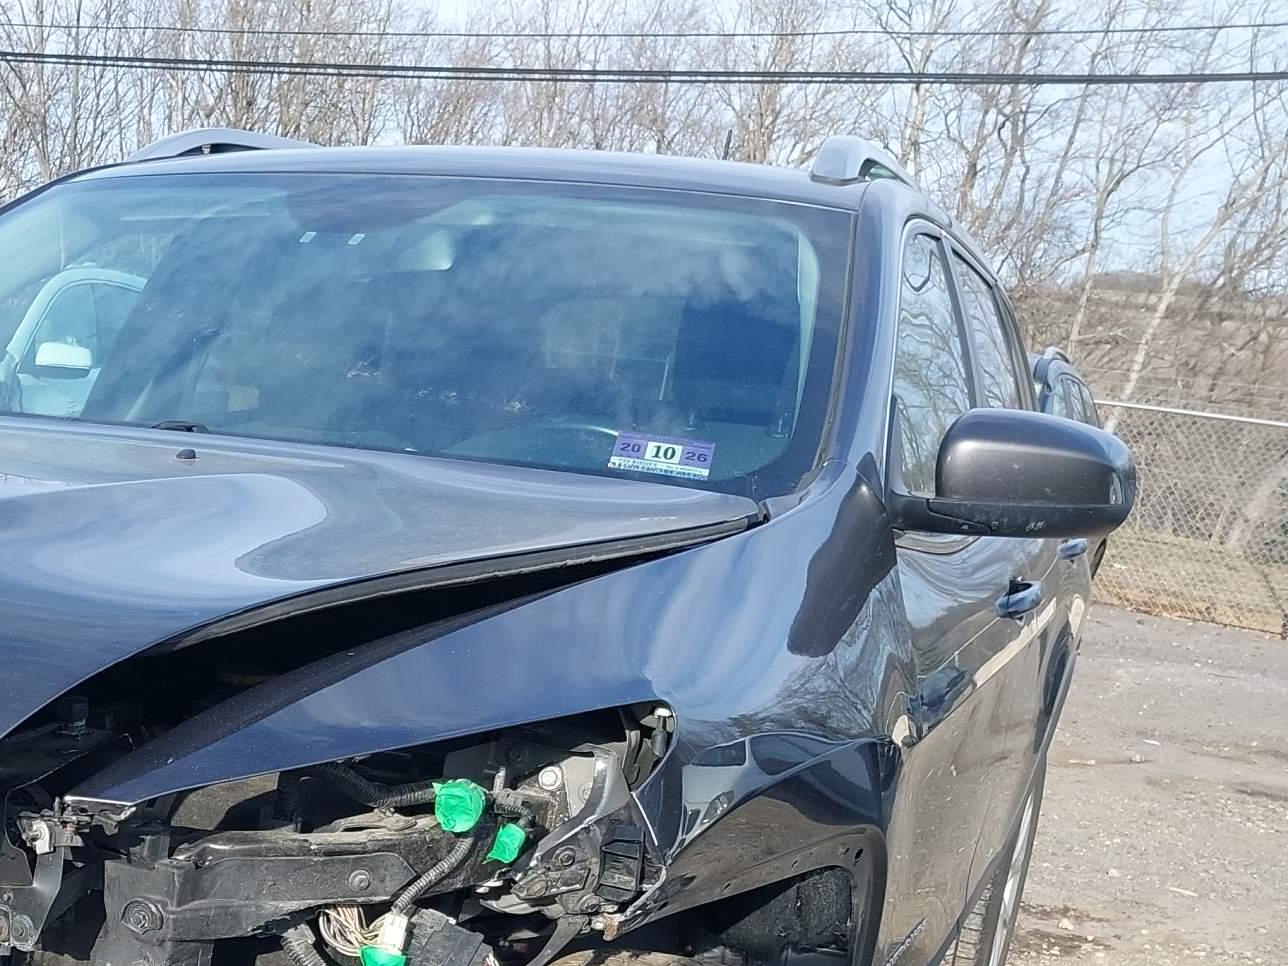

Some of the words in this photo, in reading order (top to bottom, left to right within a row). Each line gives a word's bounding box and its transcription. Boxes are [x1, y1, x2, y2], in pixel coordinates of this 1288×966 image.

[620, 442, 641, 453] 20
[650, 445, 676, 460] 10
[684, 451, 707, 463] 26
